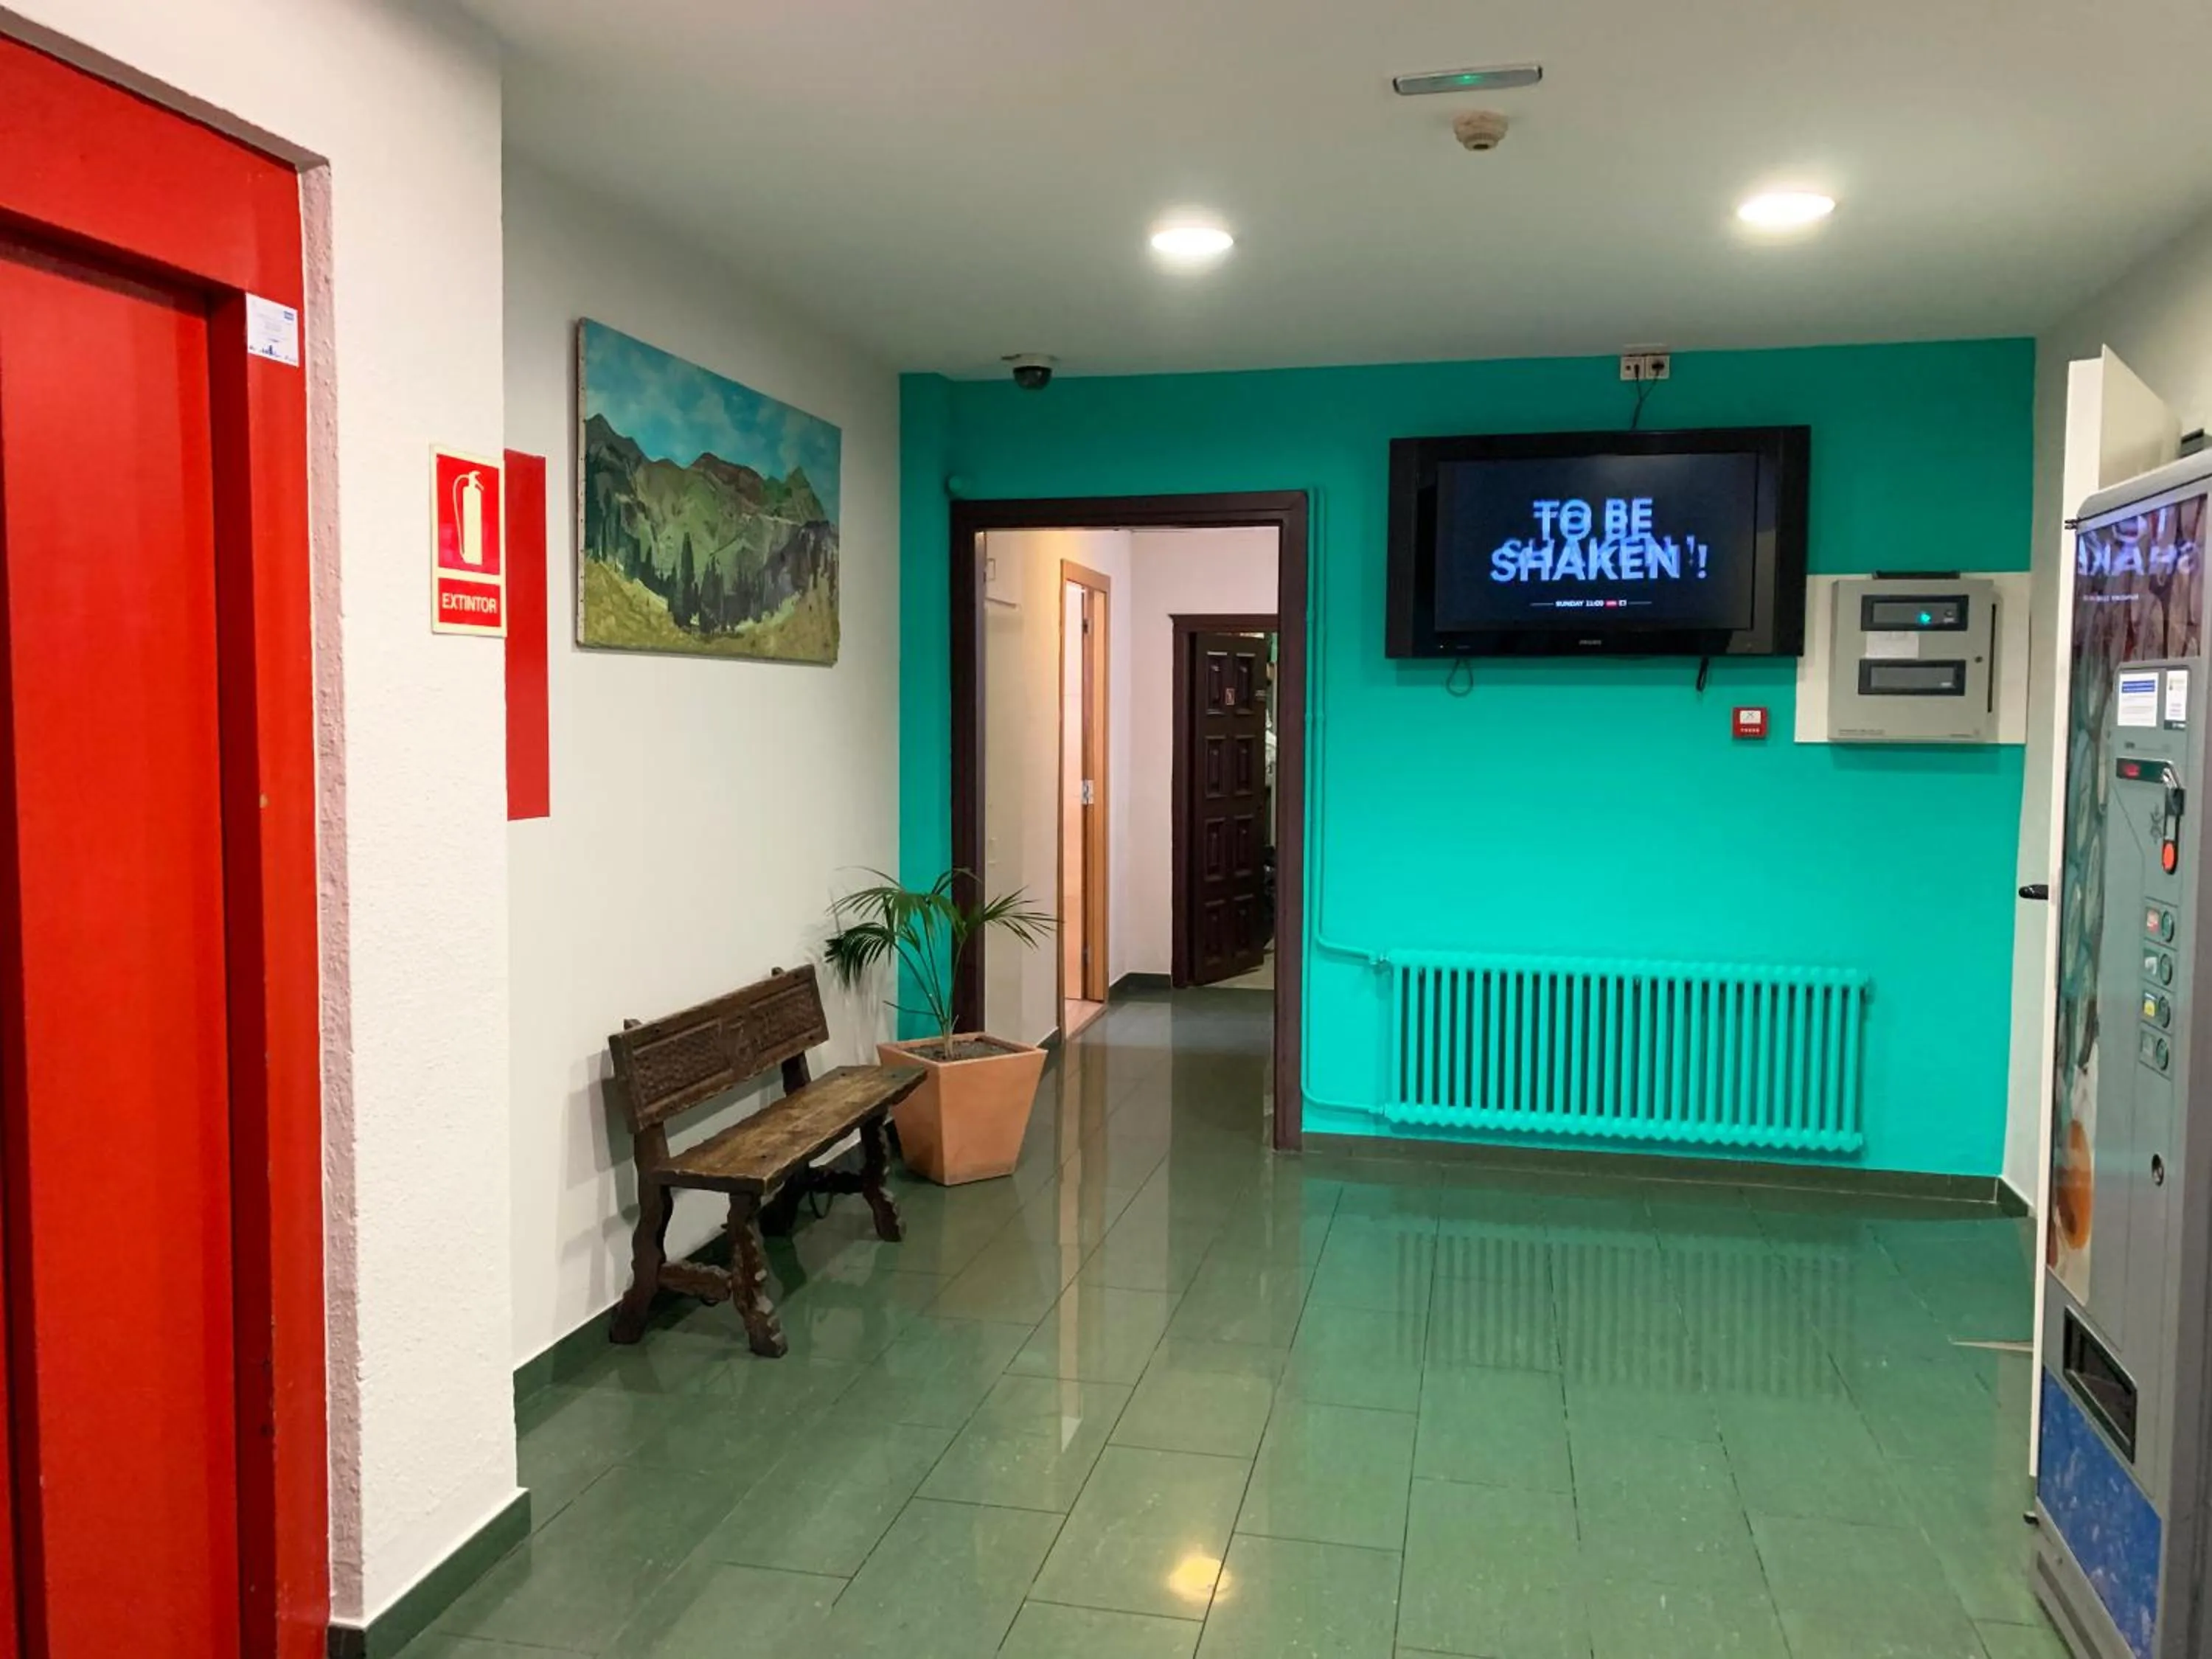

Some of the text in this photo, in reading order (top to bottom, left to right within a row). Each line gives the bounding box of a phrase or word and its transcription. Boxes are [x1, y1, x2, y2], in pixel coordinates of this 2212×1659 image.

[1533, 498, 1652, 541] TO BE
[442, 592, 498, 613] EXTINTOR
